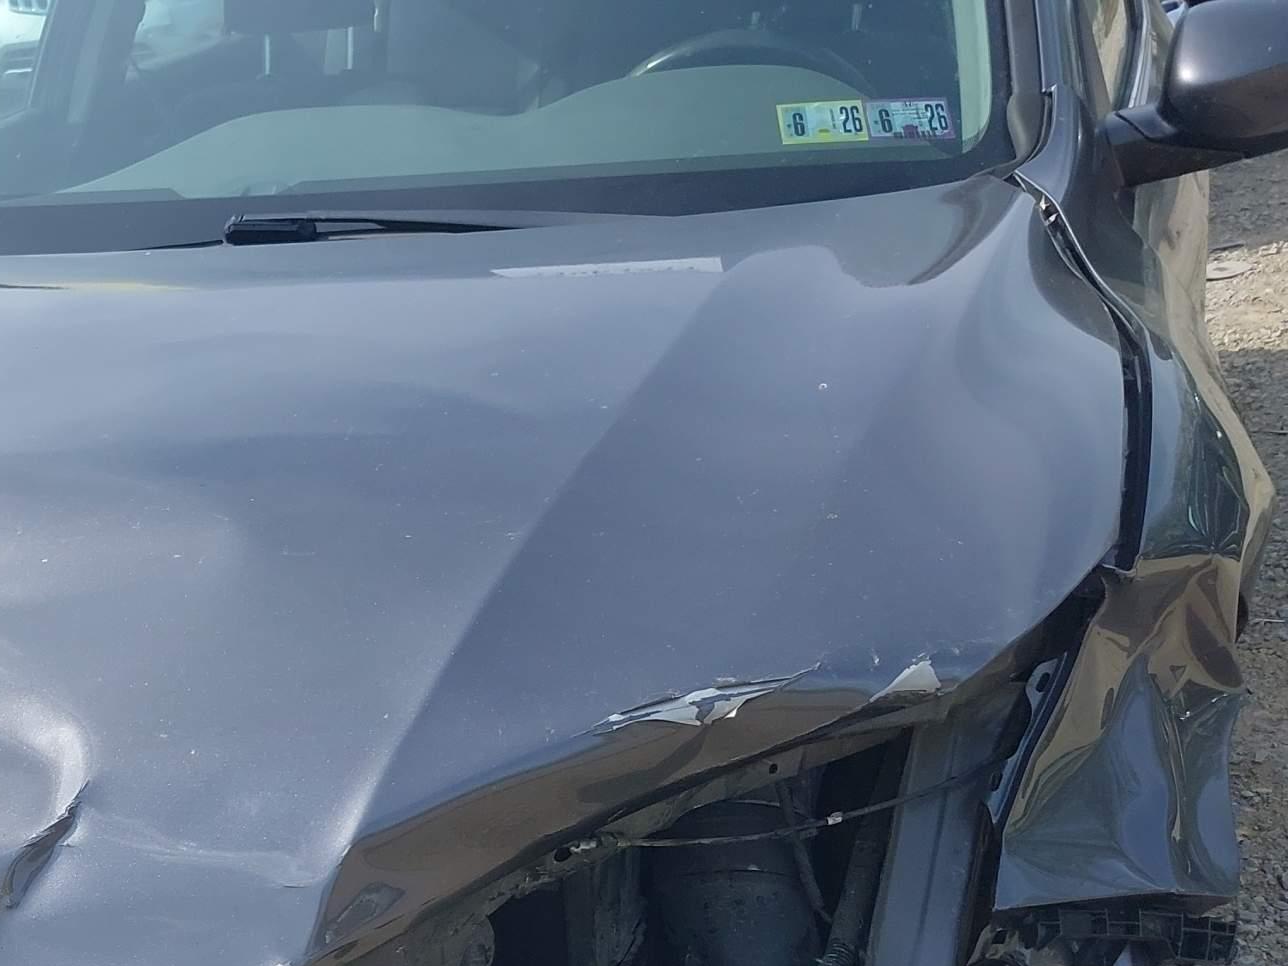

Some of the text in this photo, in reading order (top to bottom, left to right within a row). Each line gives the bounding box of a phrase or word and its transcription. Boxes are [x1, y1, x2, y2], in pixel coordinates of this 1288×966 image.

[792, 112, 806, 137] 6
[839, 105, 863, 134] 26
[878, 108, 894, 134] 6
[924, 103, 949, 131] 26
